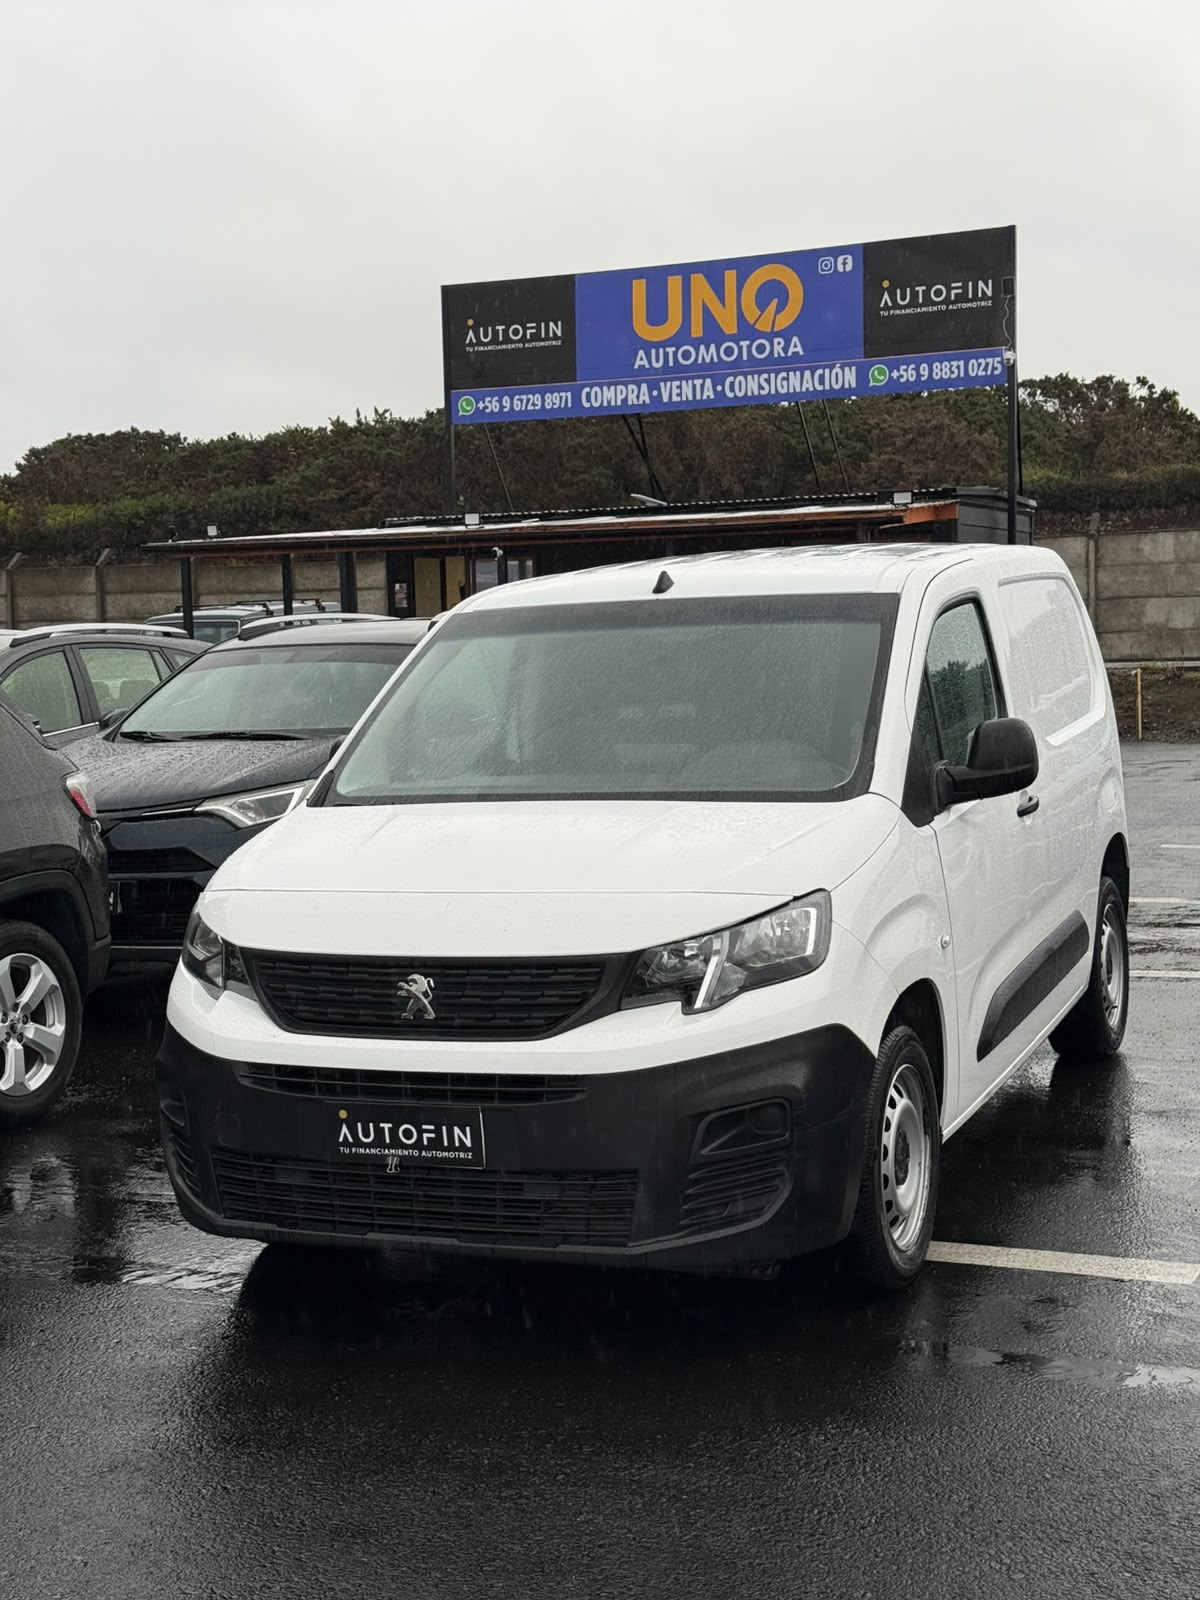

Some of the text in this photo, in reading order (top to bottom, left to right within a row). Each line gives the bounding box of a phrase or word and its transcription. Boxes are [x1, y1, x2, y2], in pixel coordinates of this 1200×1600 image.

[632, 263, 804, 342] UNO
[880, 279, 992, 308] AUTOFIN
[890, 304, 947, 315] FINANCIAMIENTO
[948, 300, 993, 310] AUTOMOTRIZ
[465, 319, 562, 344] AUTOFIN
[474, 342, 523, 352] FINANCIAMIENTO
[524, 340, 562, 348] AUTOMOTRIZ
[633, 336, 805, 369] AUTOMOTORA
[891, 357, 1002, 382] +56 9 8831 0275
[477, 391, 572, 413] +56 9 6729 8971
[338, 1120, 472, 1148] AUTOFIN
[339, 1146, 473, 1160] TU FINANCIAMIENTO AUTOMOTRIZ
